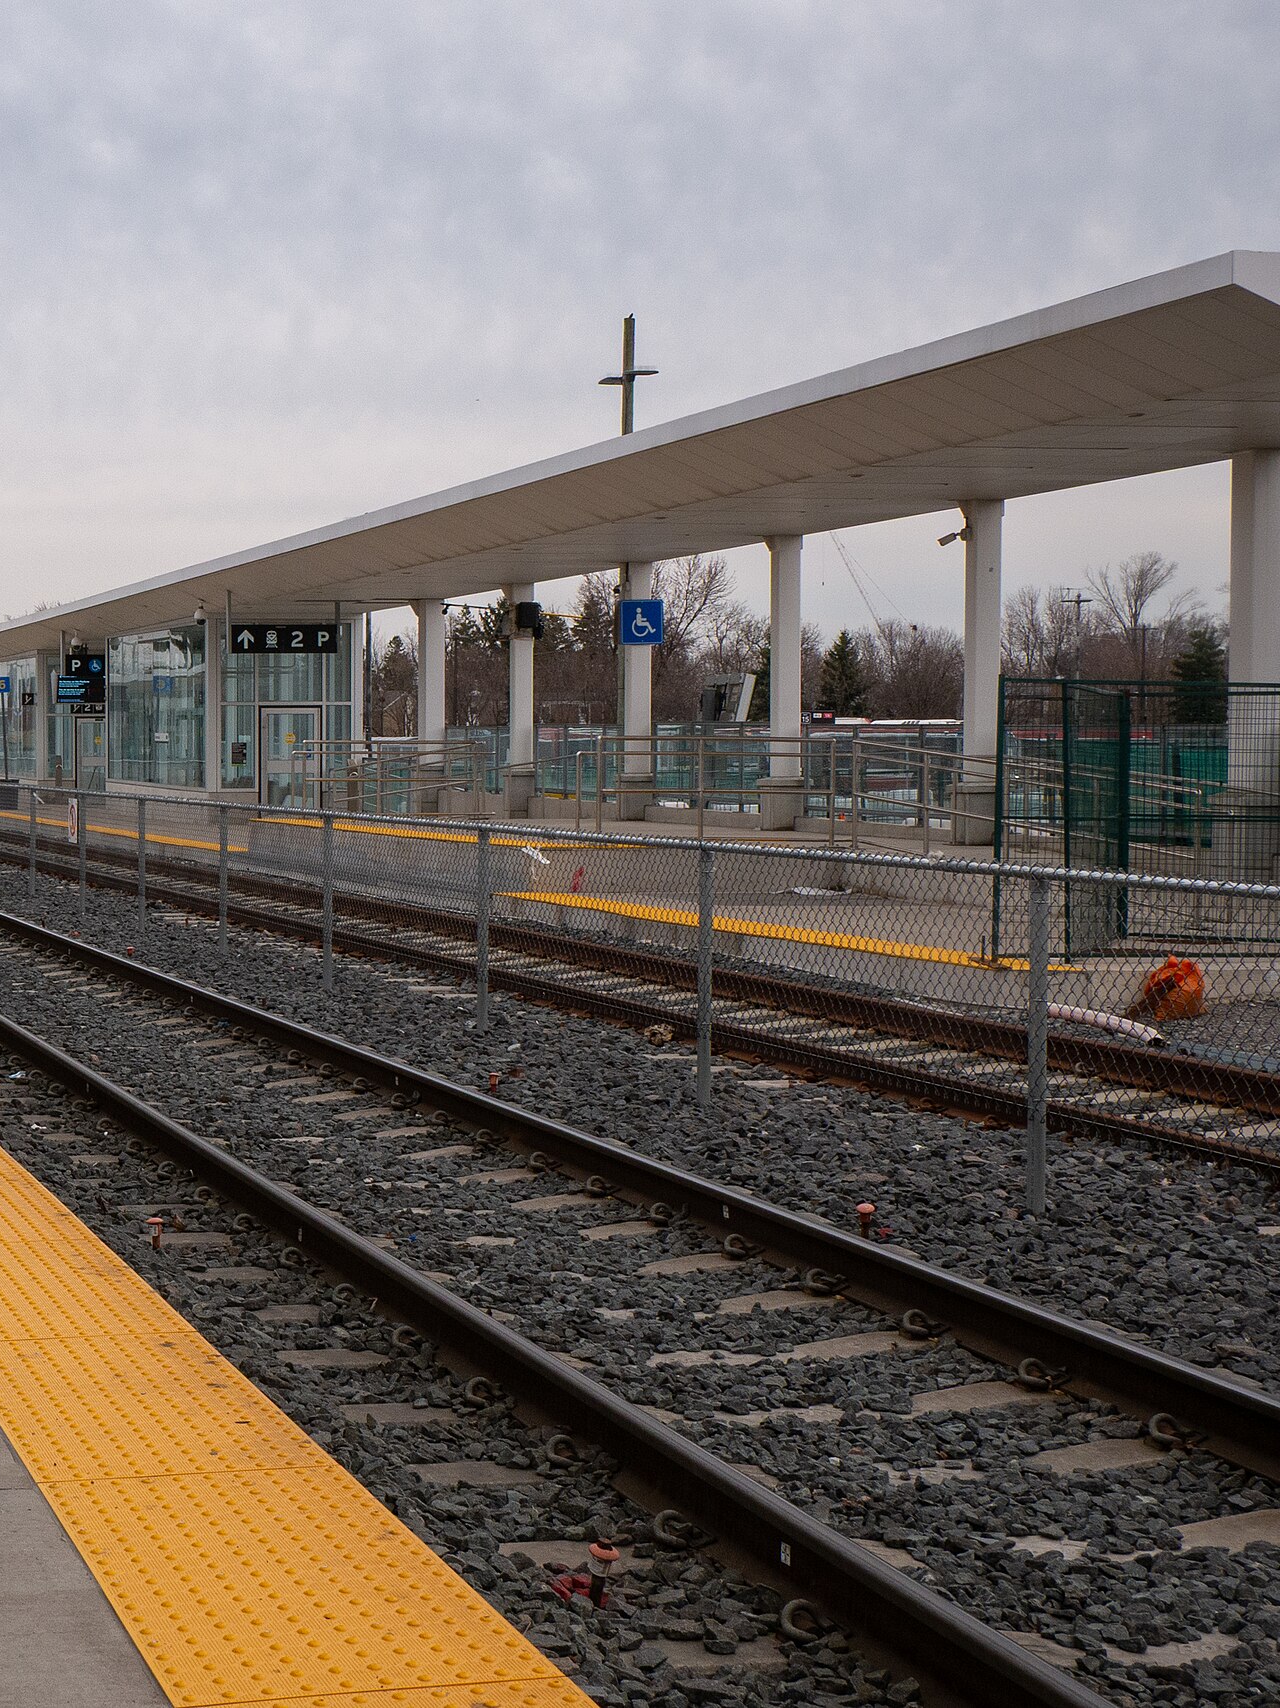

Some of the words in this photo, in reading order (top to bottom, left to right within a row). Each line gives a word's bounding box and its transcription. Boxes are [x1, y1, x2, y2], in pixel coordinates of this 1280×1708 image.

[291, 631, 304, 648] 2
[318, 631, 330, 647] P
[72, 660, 81, 672] P
